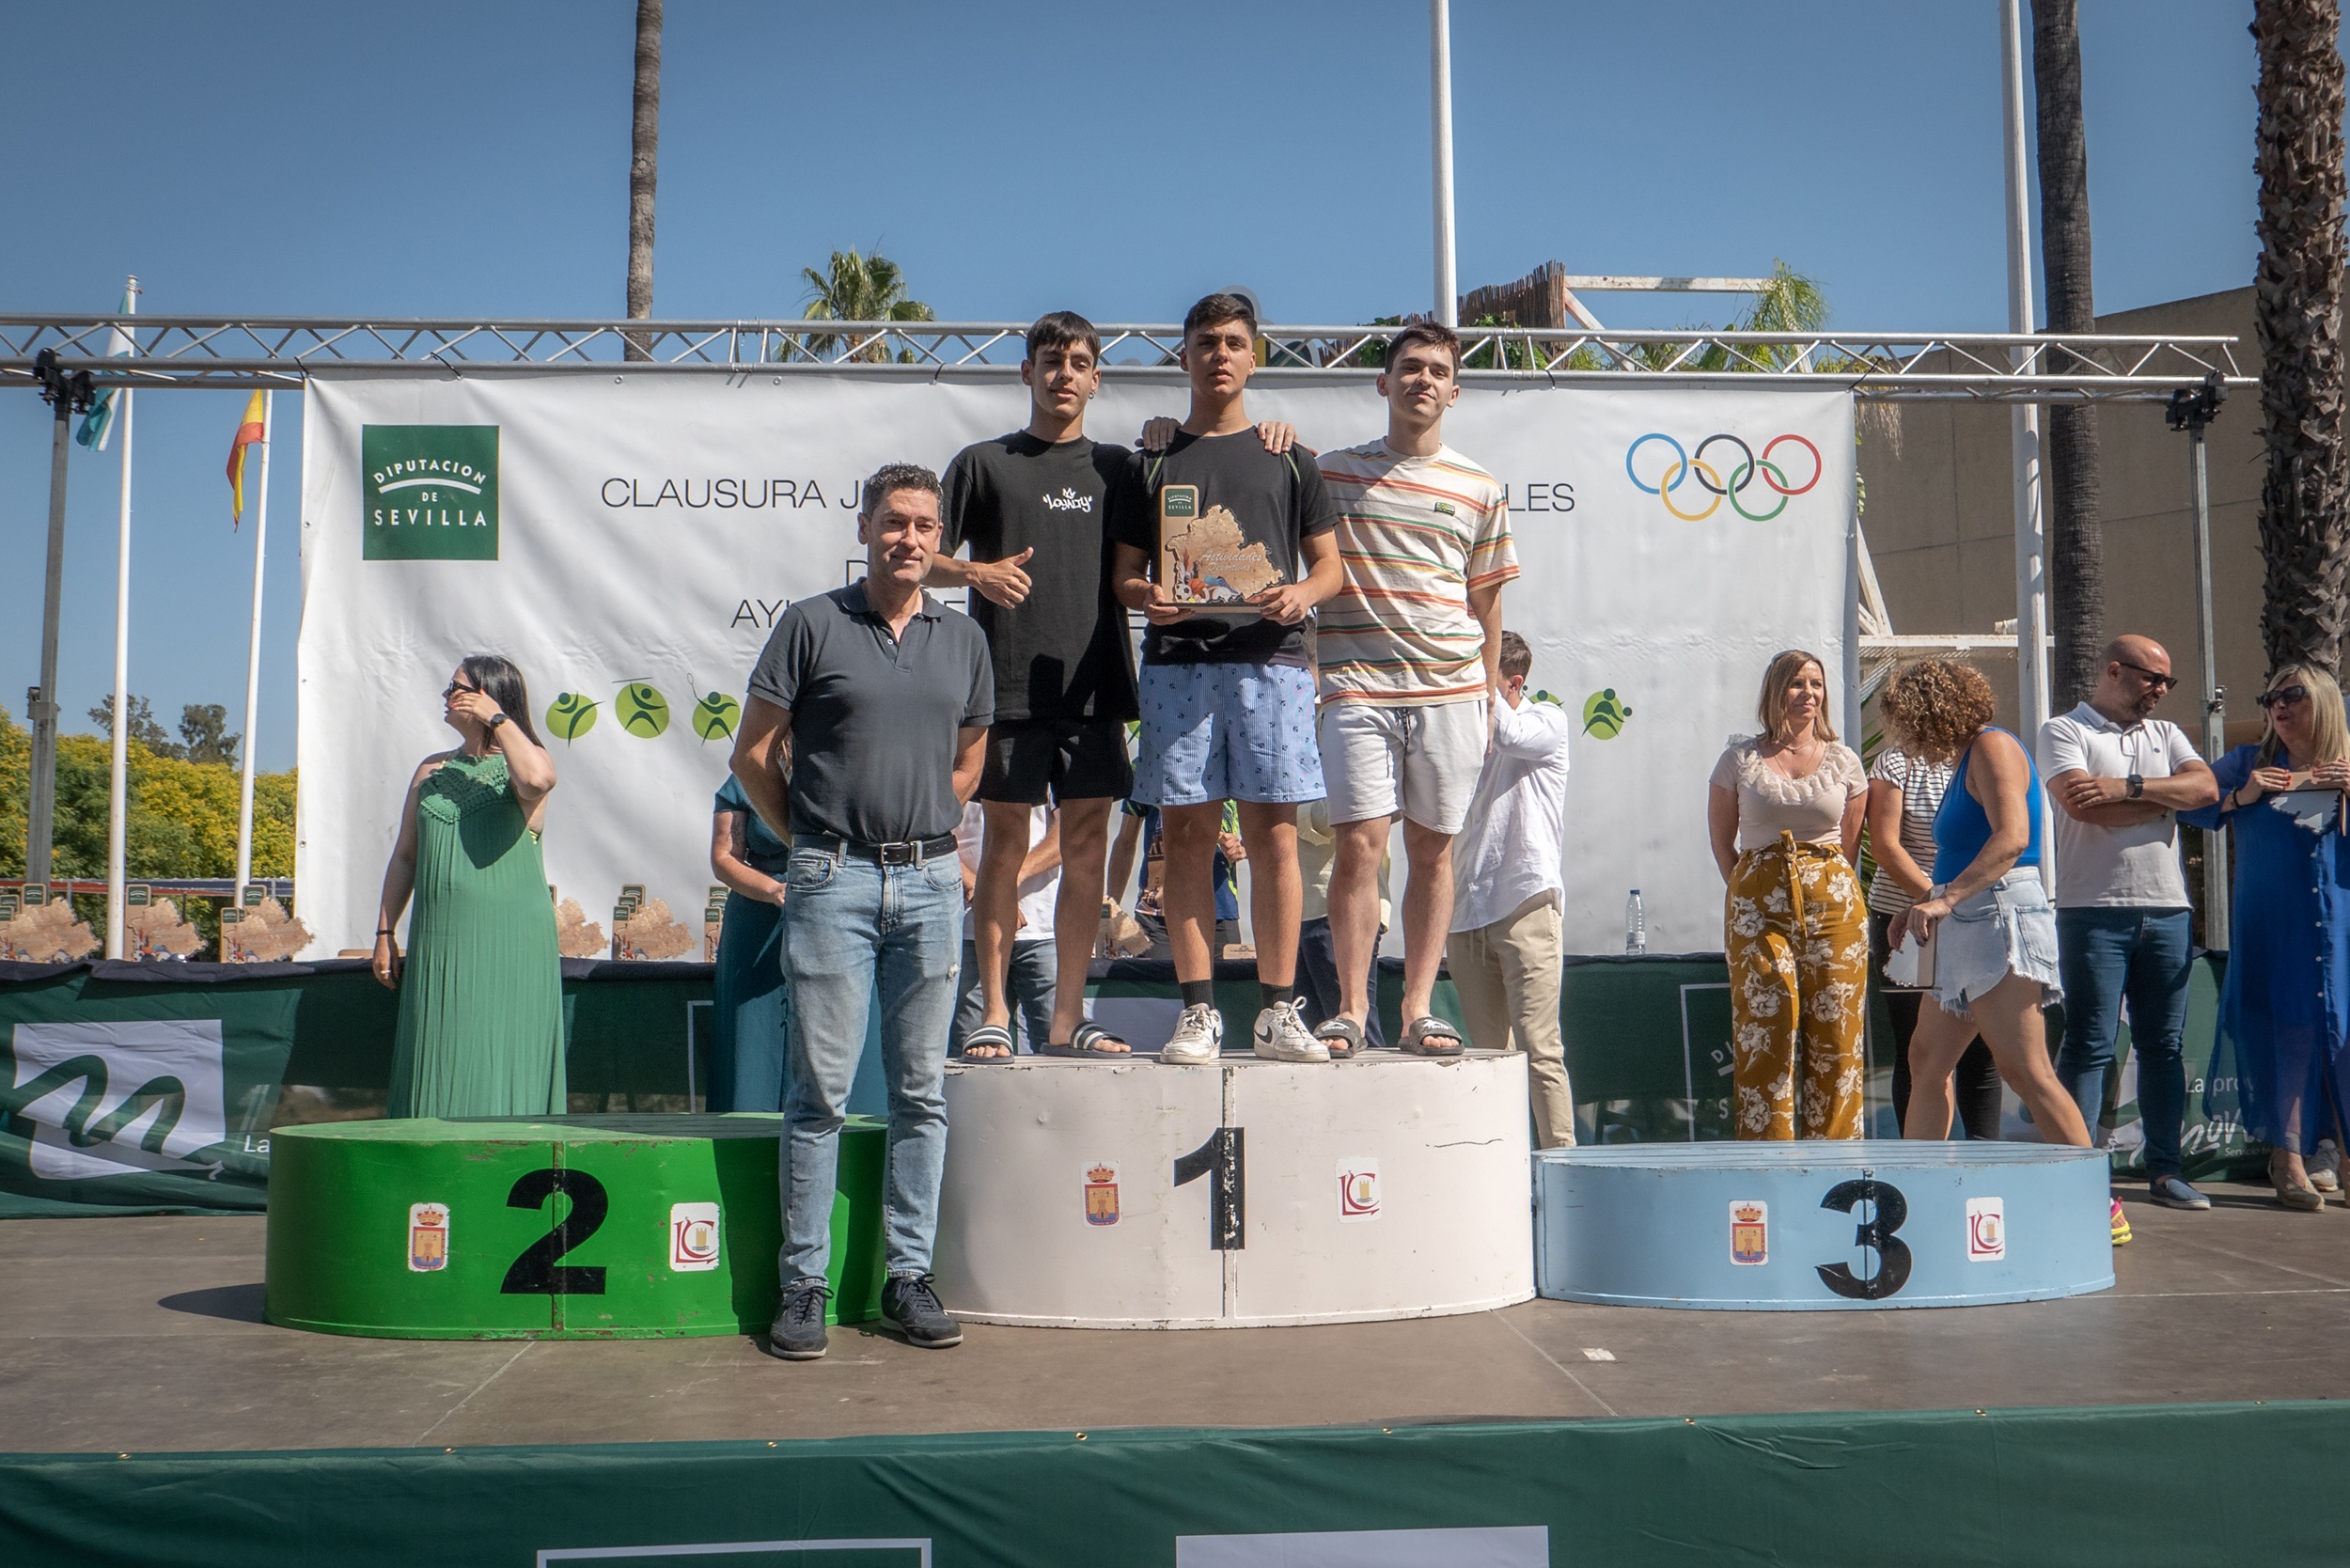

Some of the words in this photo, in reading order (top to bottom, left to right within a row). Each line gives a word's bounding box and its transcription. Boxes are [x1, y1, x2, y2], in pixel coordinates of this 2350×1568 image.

[372, 459, 487, 485] DIPUTACION
[421, 492, 439, 502] DE
[602, 478, 827, 509] CLAUSURA
[374, 509, 487, 526] SEVILLA
[1199, 550, 1263, 562] Actividades
[244, 1135, 270, 1153] La
[1173, 1126, 1246, 1251] 1
[500, 1168, 609, 1295] 2
[1814, 1179, 1912, 1301] 3
